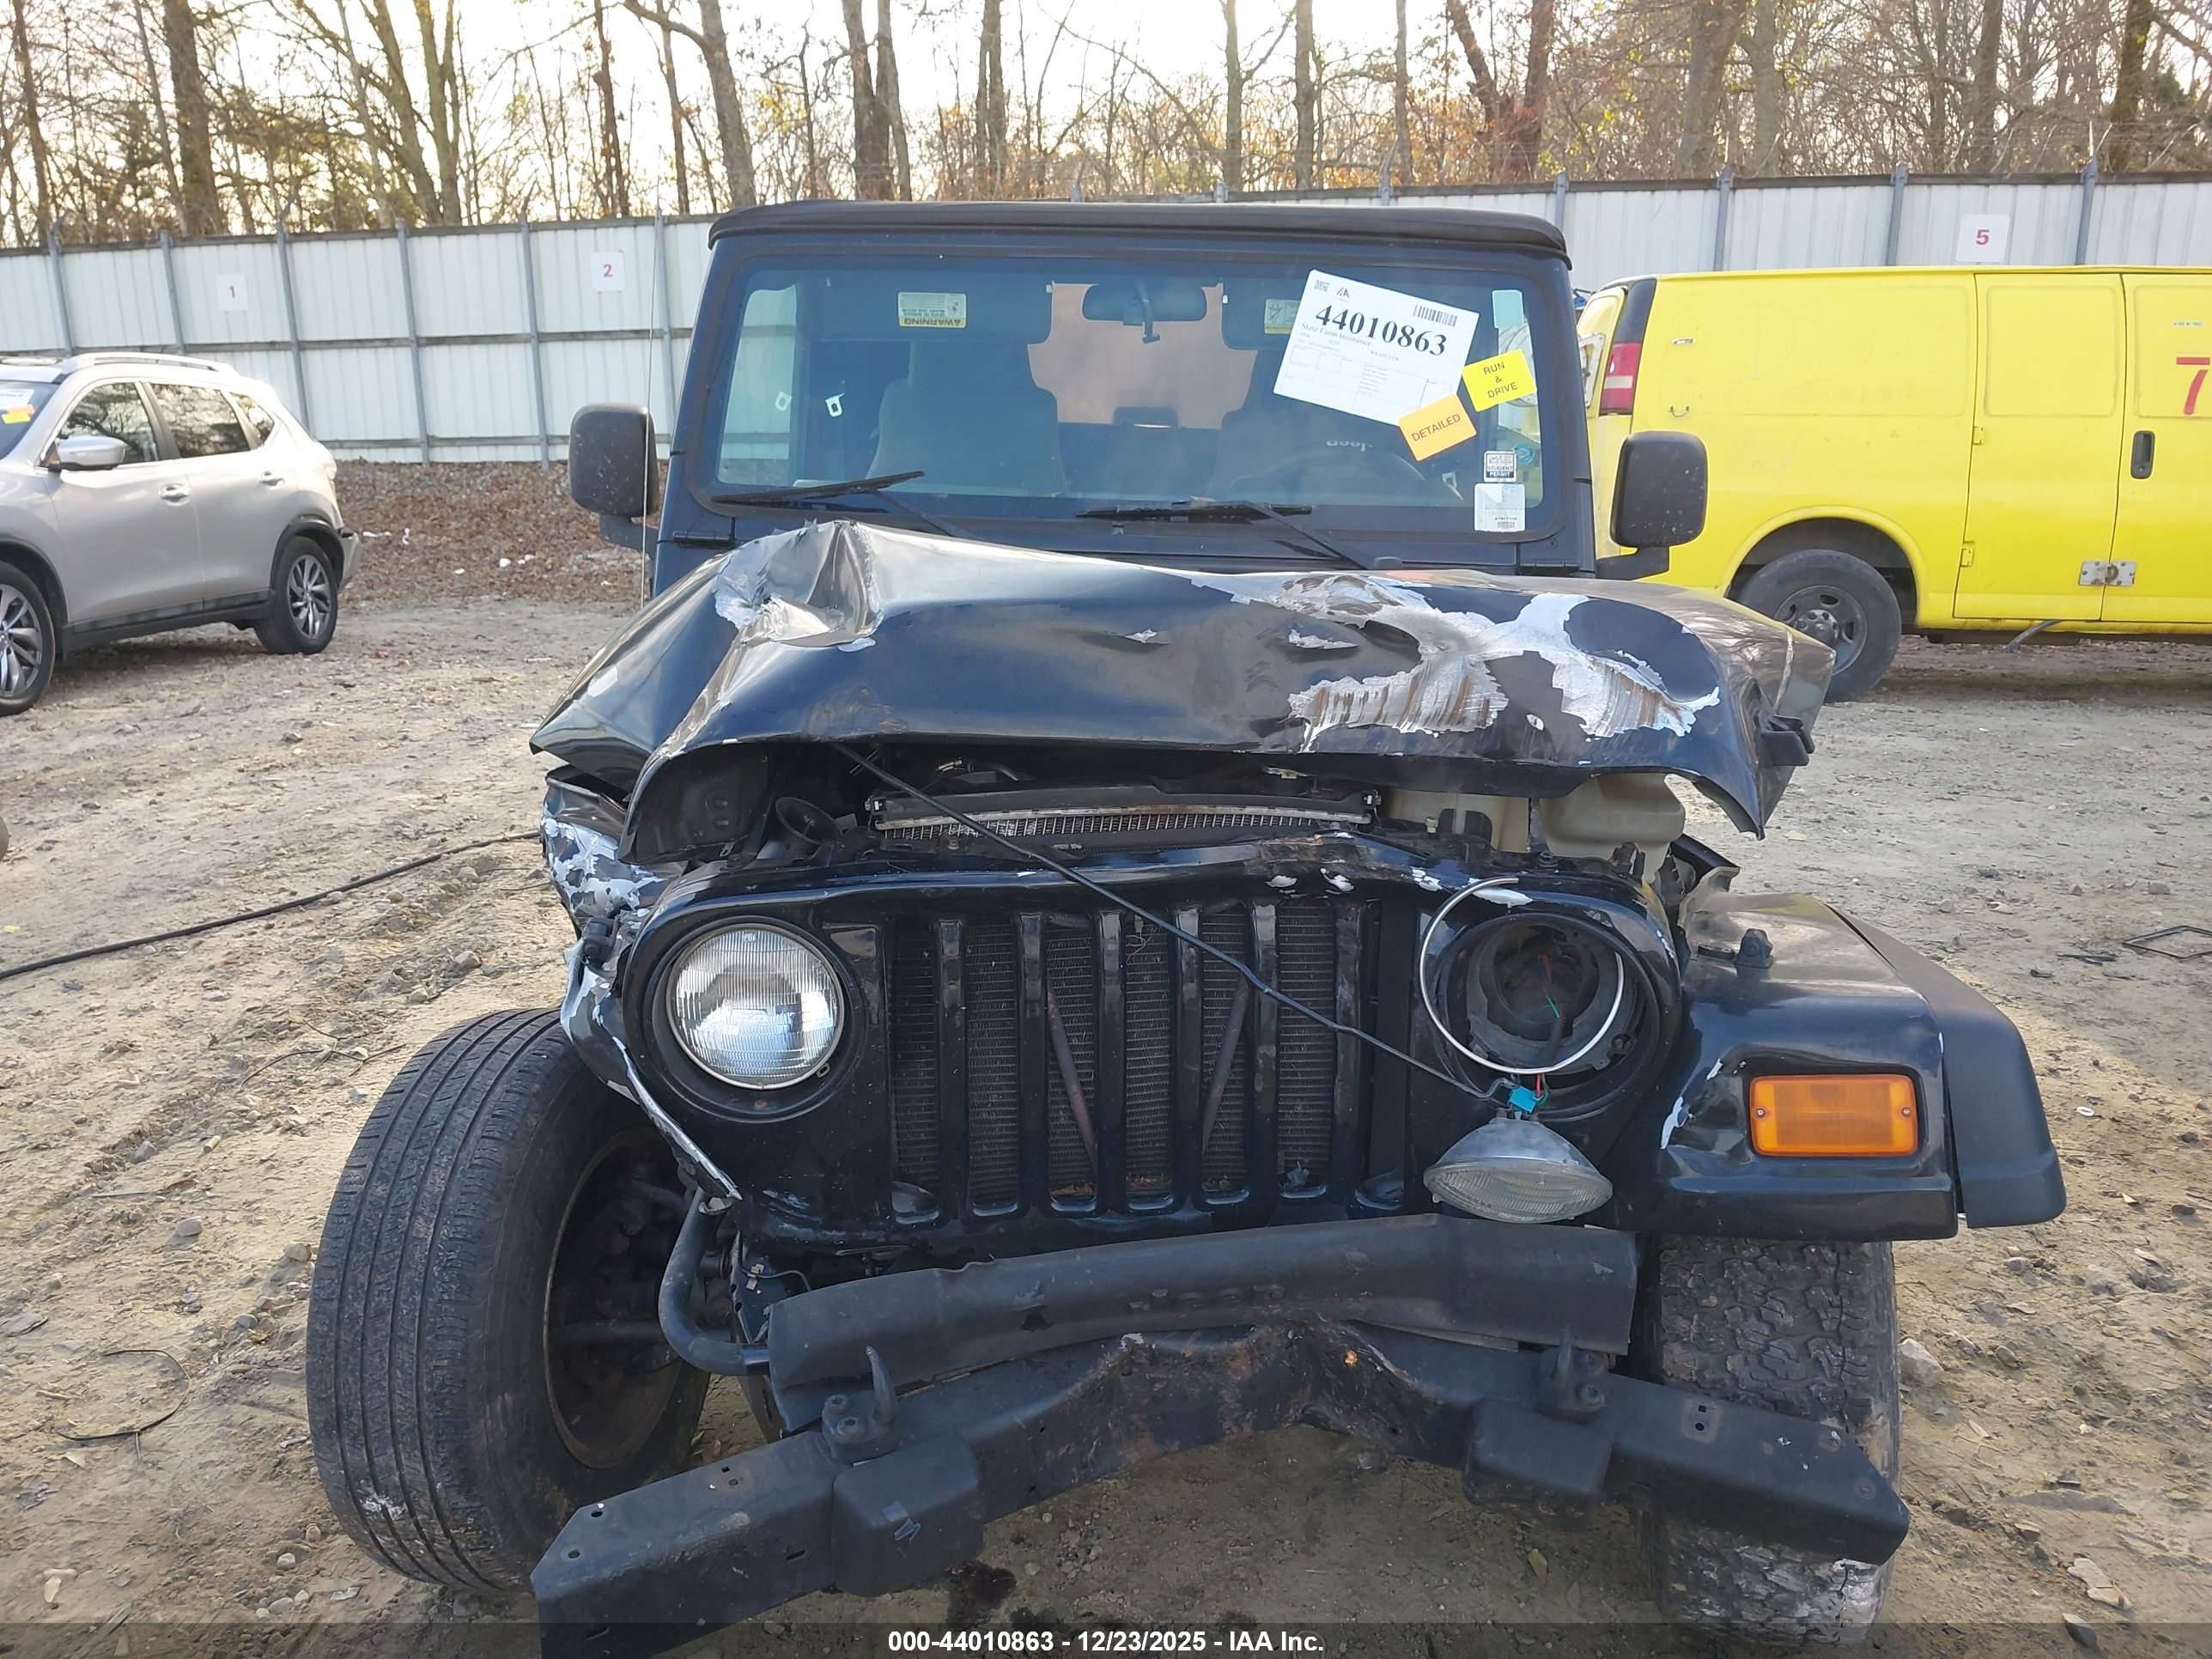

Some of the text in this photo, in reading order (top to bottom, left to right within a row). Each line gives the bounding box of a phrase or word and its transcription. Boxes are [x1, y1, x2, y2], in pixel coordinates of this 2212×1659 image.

[1976, 228, 1990, 246] 5
[604, 263, 613, 277] 2
[228, 285, 235, 299] 1
[1315, 304, 1447, 356] 44010863
[1483, 362, 1505, 375] RUN
[1487, 381, 1518, 398] DRIVE
[2175, 356, 2211, 415] 7
[1412, 413, 1462, 441] DETAILED
